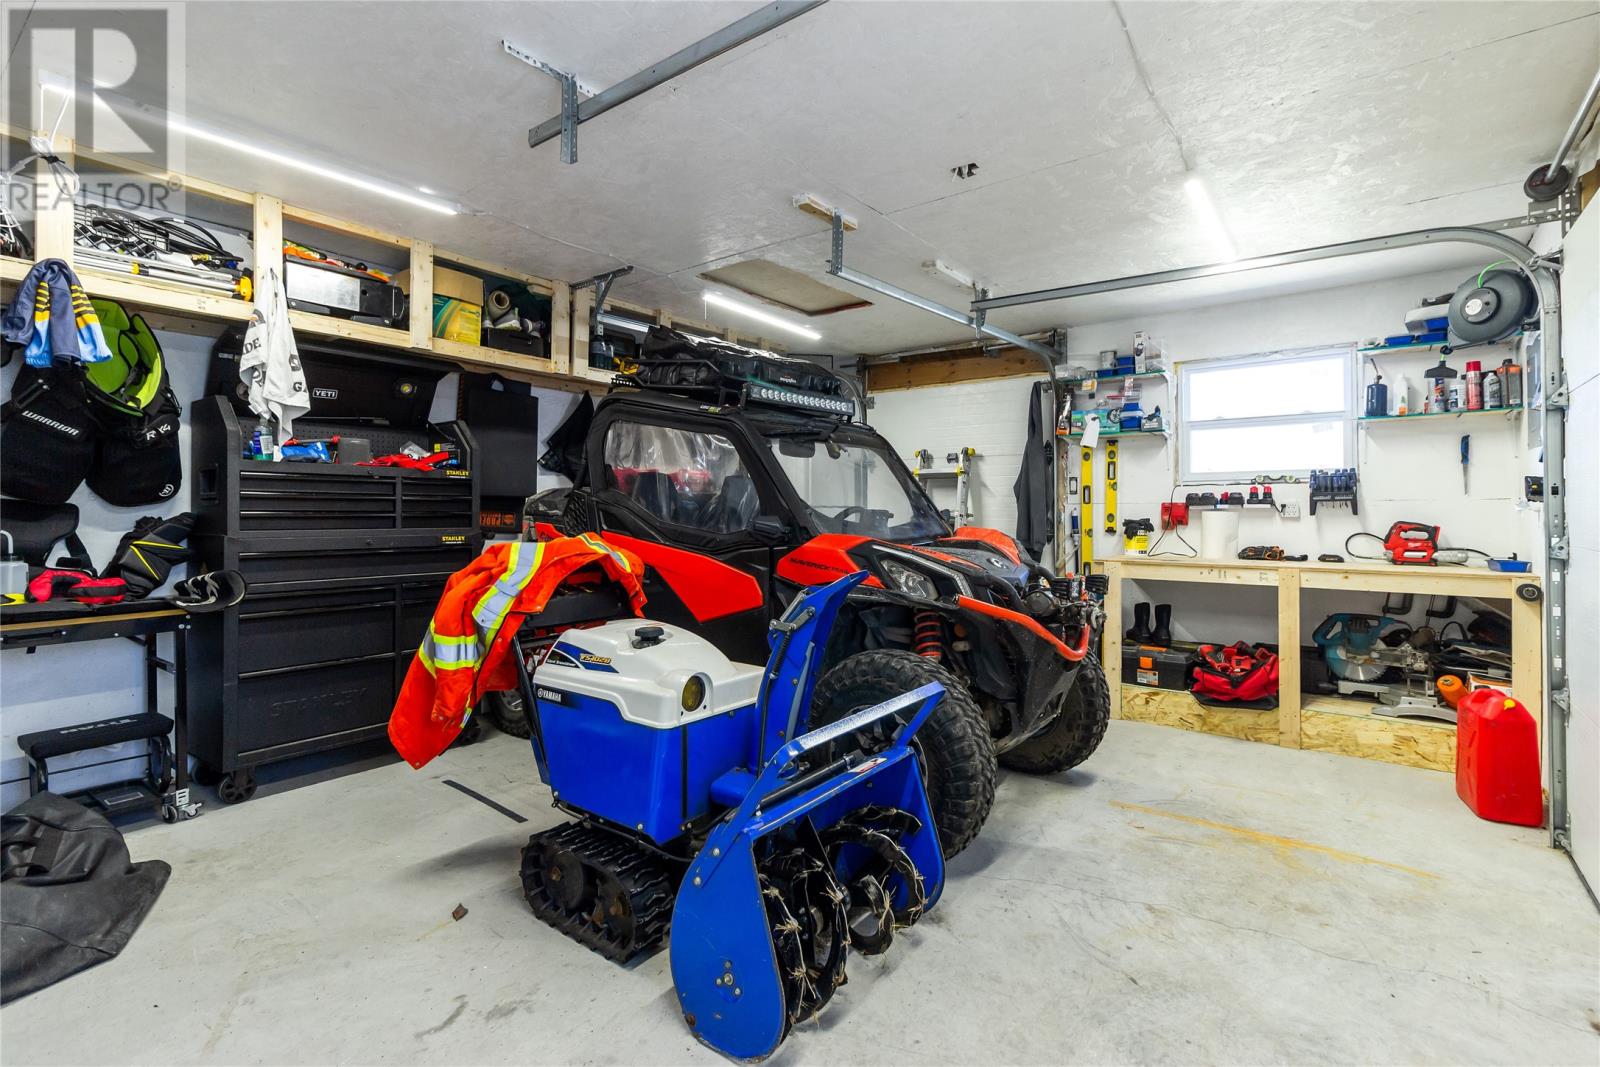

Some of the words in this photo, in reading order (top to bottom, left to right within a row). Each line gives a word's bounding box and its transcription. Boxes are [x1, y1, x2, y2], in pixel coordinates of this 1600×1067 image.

[315, 390, 335, 398] YETI
[22, 410, 80, 436] WARRIOR
[543, 689, 562, 703] YAMAHA
